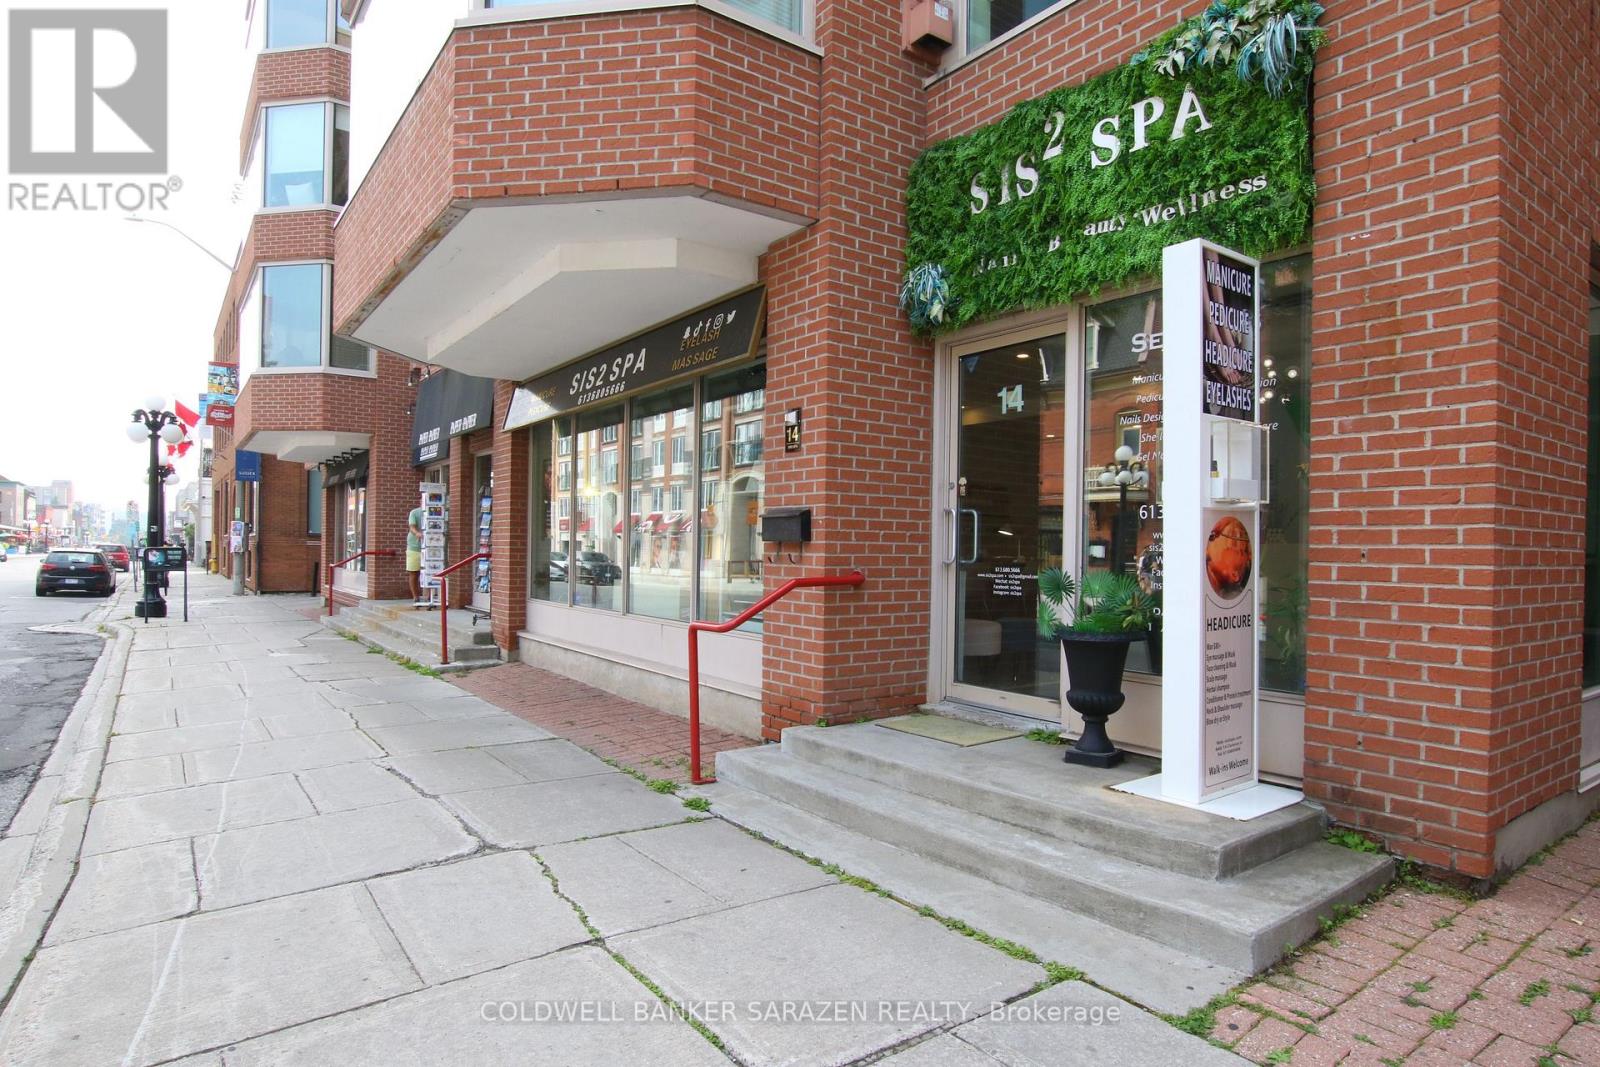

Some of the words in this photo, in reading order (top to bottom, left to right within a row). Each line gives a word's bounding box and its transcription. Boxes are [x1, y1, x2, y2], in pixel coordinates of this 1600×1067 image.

[1090, 83, 1213, 169] SPA
[1141, 173, 1269, 228] Wellness
[1206, 260, 1252, 297] MANICURE
[1209, 300, 1250, 335] PEDICURE
[679, 328, 722, 352] EYELASH
[569, 362, 608, 396] SIS2
[609, 347, 647, 382] SPA
[672, 346, 720, 372] MASSAGE
[1205, 339, 1253, 374] HEADICURE
[577, 380, 626, 406] 6136805666
[997, 384, 1025, 415] 14
[1206, 380, 1252, 412] EYELASHES
[786, 426, 799, 443] 14
[1120, 414, 1141, 426] Nails
[1206, 614, 1251, 632] HEADICURE
[1228, 758, 1249, 771] Welcome
